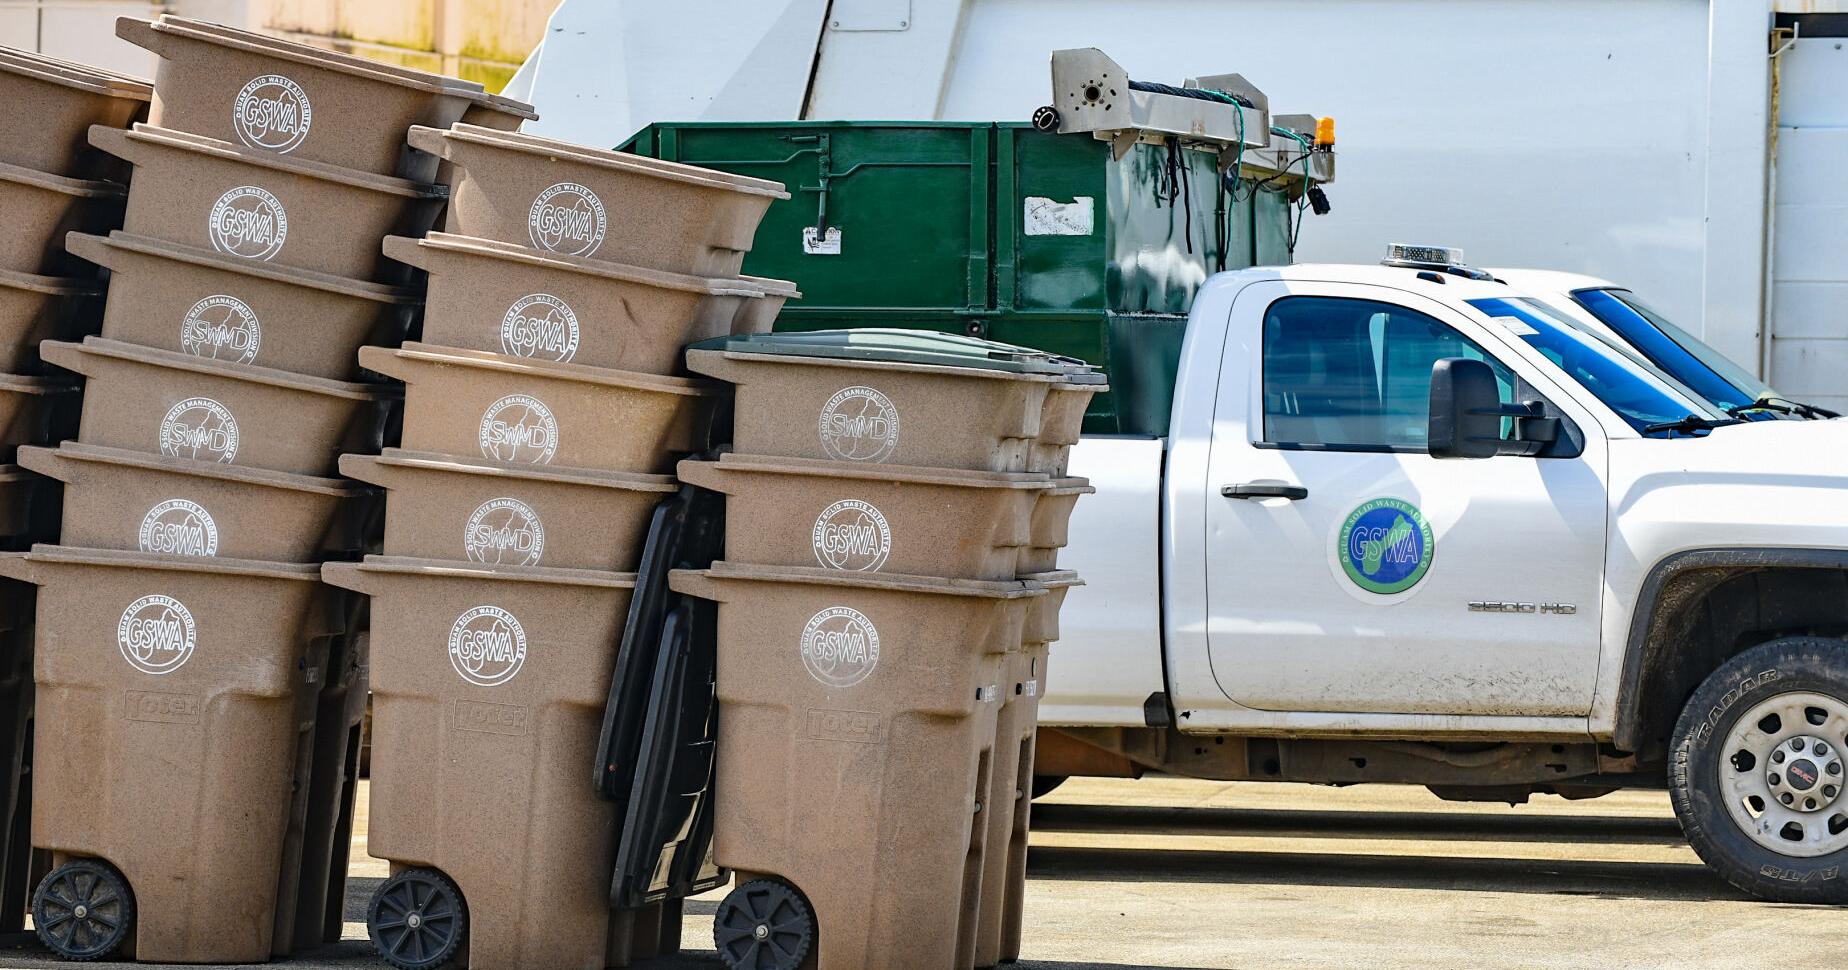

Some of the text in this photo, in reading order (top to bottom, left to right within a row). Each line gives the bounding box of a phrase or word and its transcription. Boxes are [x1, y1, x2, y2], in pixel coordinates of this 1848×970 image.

[237, 78, 309, 126] GUAM SOLID WASTE AUTHORITY
[244, 96, 298, 134] GSWA
[212, 189, 285, 238] GUAM SOLID WASTE AUTHORITY
[220, 207, 273, 245] GSWA
[532, 185, 604, 233] GUAM SOLID WASTE AUTHORITY
[539, 204, 591, 242] GSWA
[184, 298, 258, 350] SOLID WASTE MANAGEMENT DIVISION
[191, 320, 251, 349] SWMD
[504, 296, 577, 345] GUAM SOLID WASTE AUTHORITY
[512, 316, 566, 352] GSWA
[162, 400, 236, 452] SOLID WASTE MANAGEMENT DIVISION
[487, 401, 504, 419] WASTE
[505, 397, 549, 418] MANAGEMENT
[547, 418, 556, 448] DIVISION
[825, 394, 844, 412] WASTE
[844, 389, 889, 408] MANAGEMENT
[887, 408, 896, 439] DIVISION
[829, 414, 890, 439] SWMD
[169, 423, 229, 451] SWMD
[489, 421, 548, 447] SWMD
[151, 503, 170, 517] SOLID
[173, 502, 197, 511] WASTE
[197, 510, 215, 549] AUTHORITY
[467, 501, 542, 551] SOLID WASTE MANAGEMENT DIVISION
[815, 520, 824, 540] GUAM
[843, 502, 867, 510] WASTE
[869, 509, 888, 546] AUTHORITY
[1351, 504, 1373, 524] SOLID
[1376, 500, 1408, 509] WASTE
[149, 522, 206, 556] GSWA
[474, 525, 535, 551] SWMD
[823, 524, 878, 555] GSWA
[1351, 526, 1418, 563] GSWA
[128, 600, 146, 614] SOLID
[149, 597, 173, 605] WASTE
[174, 604, 193, 641] AUTHORITY
[129, 618, 184, 650] GSWA
[451, 608, 524, 653] GUAM SOLID WASTE AUTHORITY
[812, 612, 830, 626] SOLID
[857, 617, 877, 654] AUTHORITY
[459, 630, 515, 662] GSWA
[812, 631, 867, 663] GSWA
[1697, 669, 1781, 745] RADAR
[1790, 766, 1815, 785] GMC
